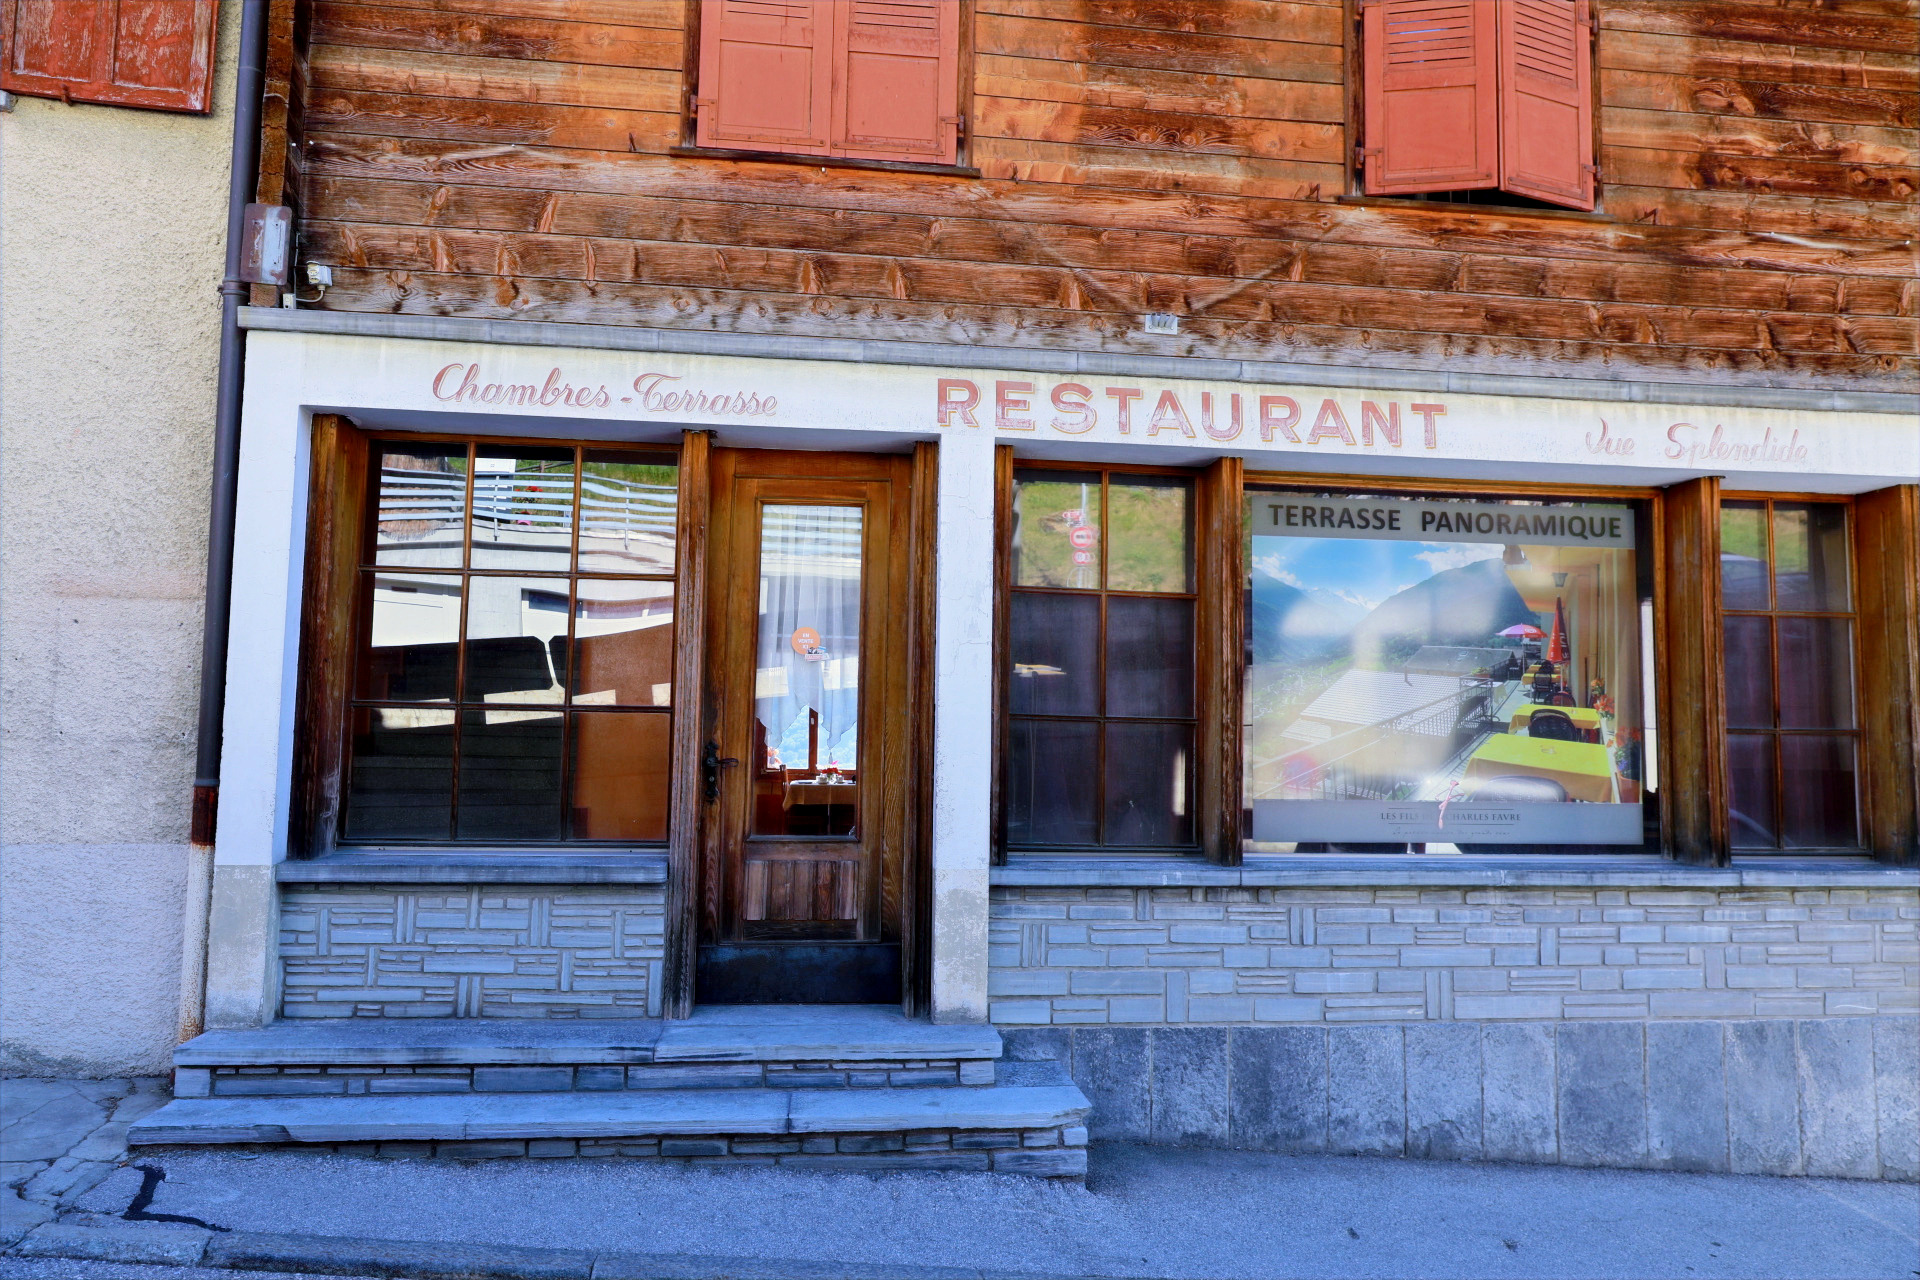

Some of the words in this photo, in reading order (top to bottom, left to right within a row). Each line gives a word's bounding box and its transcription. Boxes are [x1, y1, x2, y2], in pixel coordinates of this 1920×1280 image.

[432, 362, 611, 408] Chambres
[633, 372, 778, 417] Terrasse
[936, 377, 1447, 449] RESTAURANT
[1585, 417, 1635, 457] Vue
[1664, 422, 1809, 468] Splendide
[1267, 504, 1401, 531] TERRASSE
[1421, 510, 1622, 540] PANORAMIQUE
[1381, 812, 1396, 820] LES
[1445, 813, 1489, 821] CHARLES
[1492, 813, 1521, 821] FAVRE
